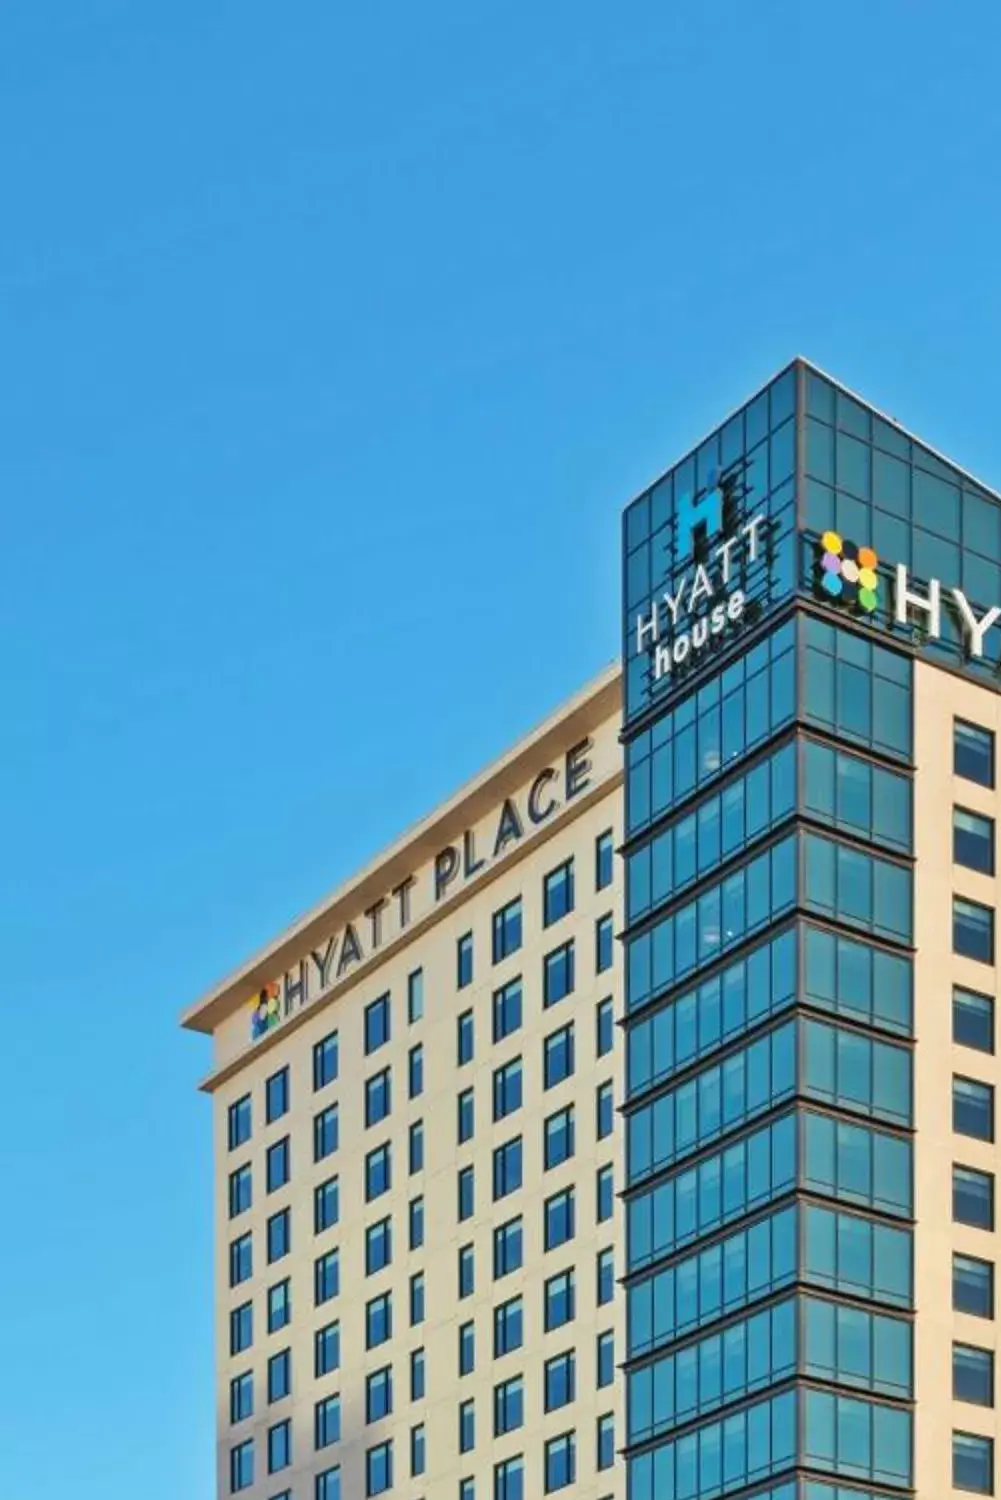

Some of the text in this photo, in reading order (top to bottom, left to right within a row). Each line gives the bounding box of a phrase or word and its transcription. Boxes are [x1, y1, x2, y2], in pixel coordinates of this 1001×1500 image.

[636, 513, 765, 653] HYATT
[655, 589, 745, 680] house
[283, 735, 594, 1018] HYATT PLACE
